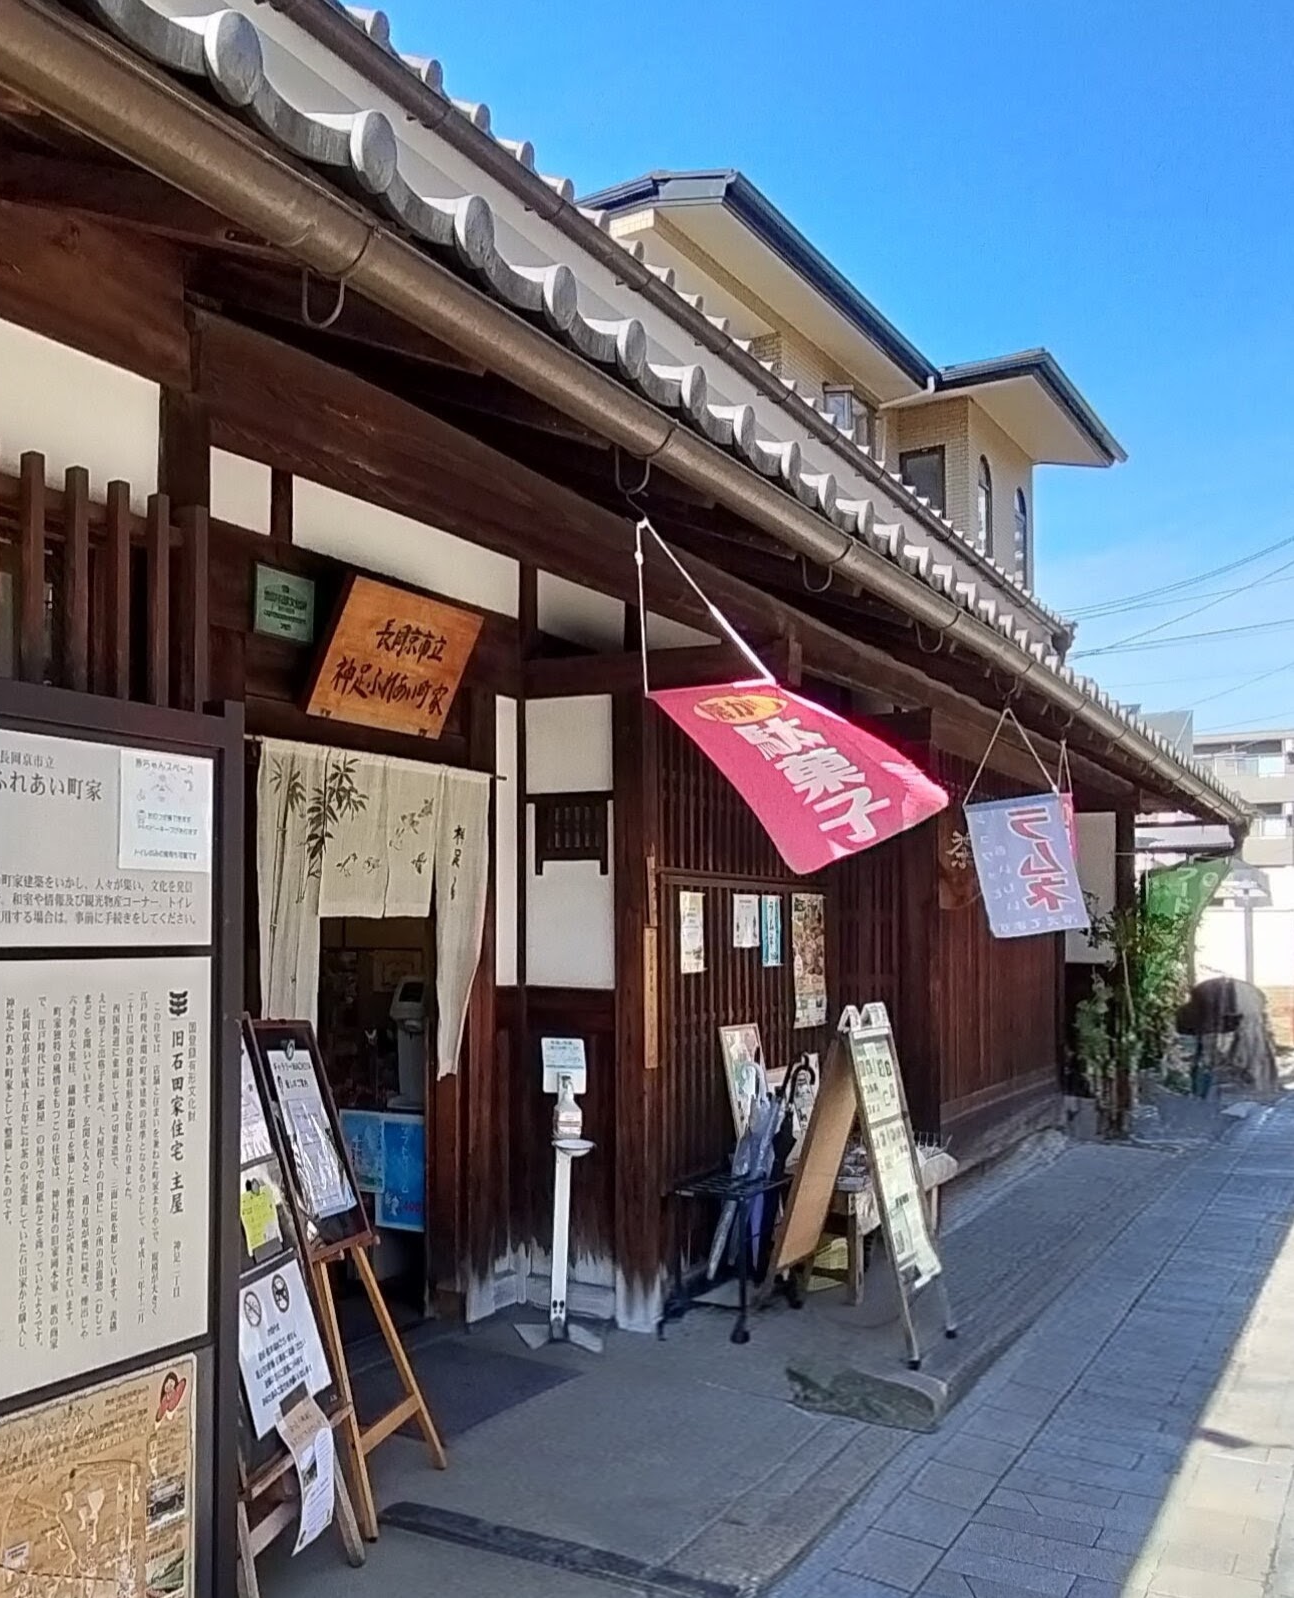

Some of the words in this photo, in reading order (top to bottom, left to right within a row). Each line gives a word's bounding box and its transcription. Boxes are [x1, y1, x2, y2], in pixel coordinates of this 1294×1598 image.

[376, 619, 447, 664] 長岡京市立
[0, 749, 55, 769] 長岡京市立
[731, 714, 892, 845] 駄菓子
[1005, 805, 1077, 914] ラムネ
[170, 1030, 185, 1162] 旧石田家住宅
[170, 1172, 184, 1214] 主屋
